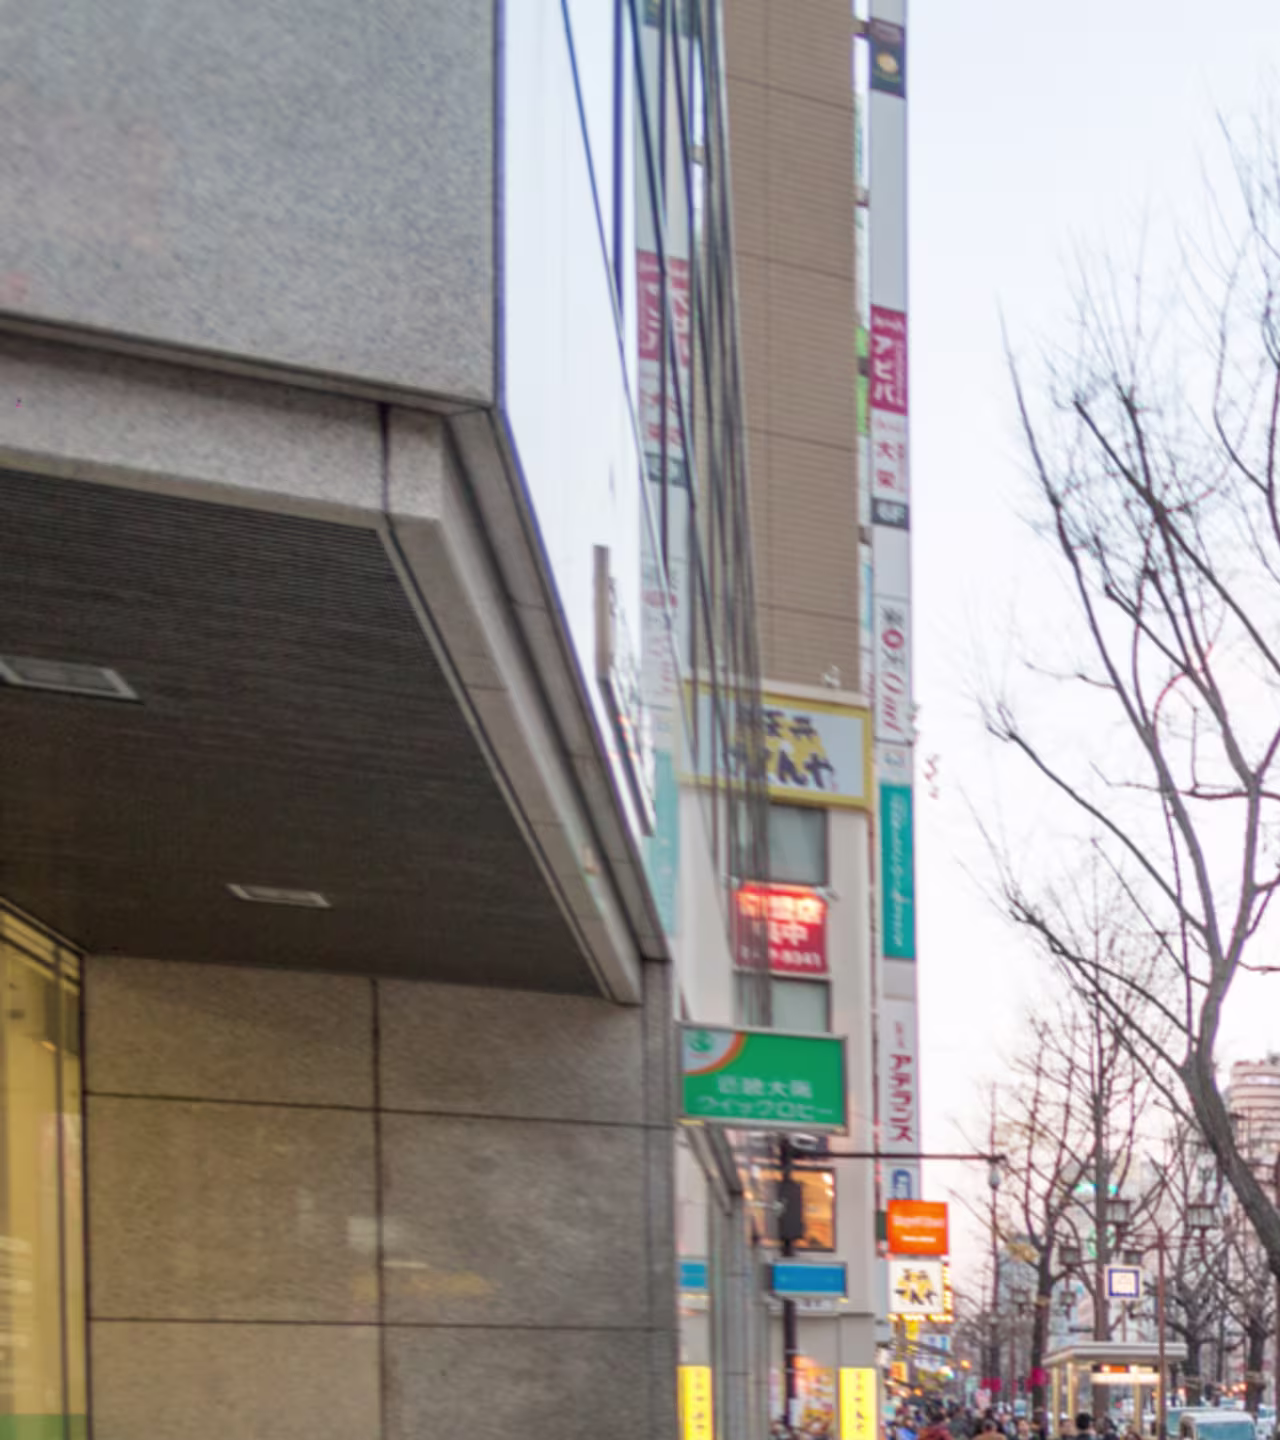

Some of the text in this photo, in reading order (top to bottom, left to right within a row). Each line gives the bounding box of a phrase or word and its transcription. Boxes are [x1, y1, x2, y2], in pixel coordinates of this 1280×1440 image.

[695, 1094, 834, 1121] クイックロビー
[889, 1053, 913, 1143] アデランス
